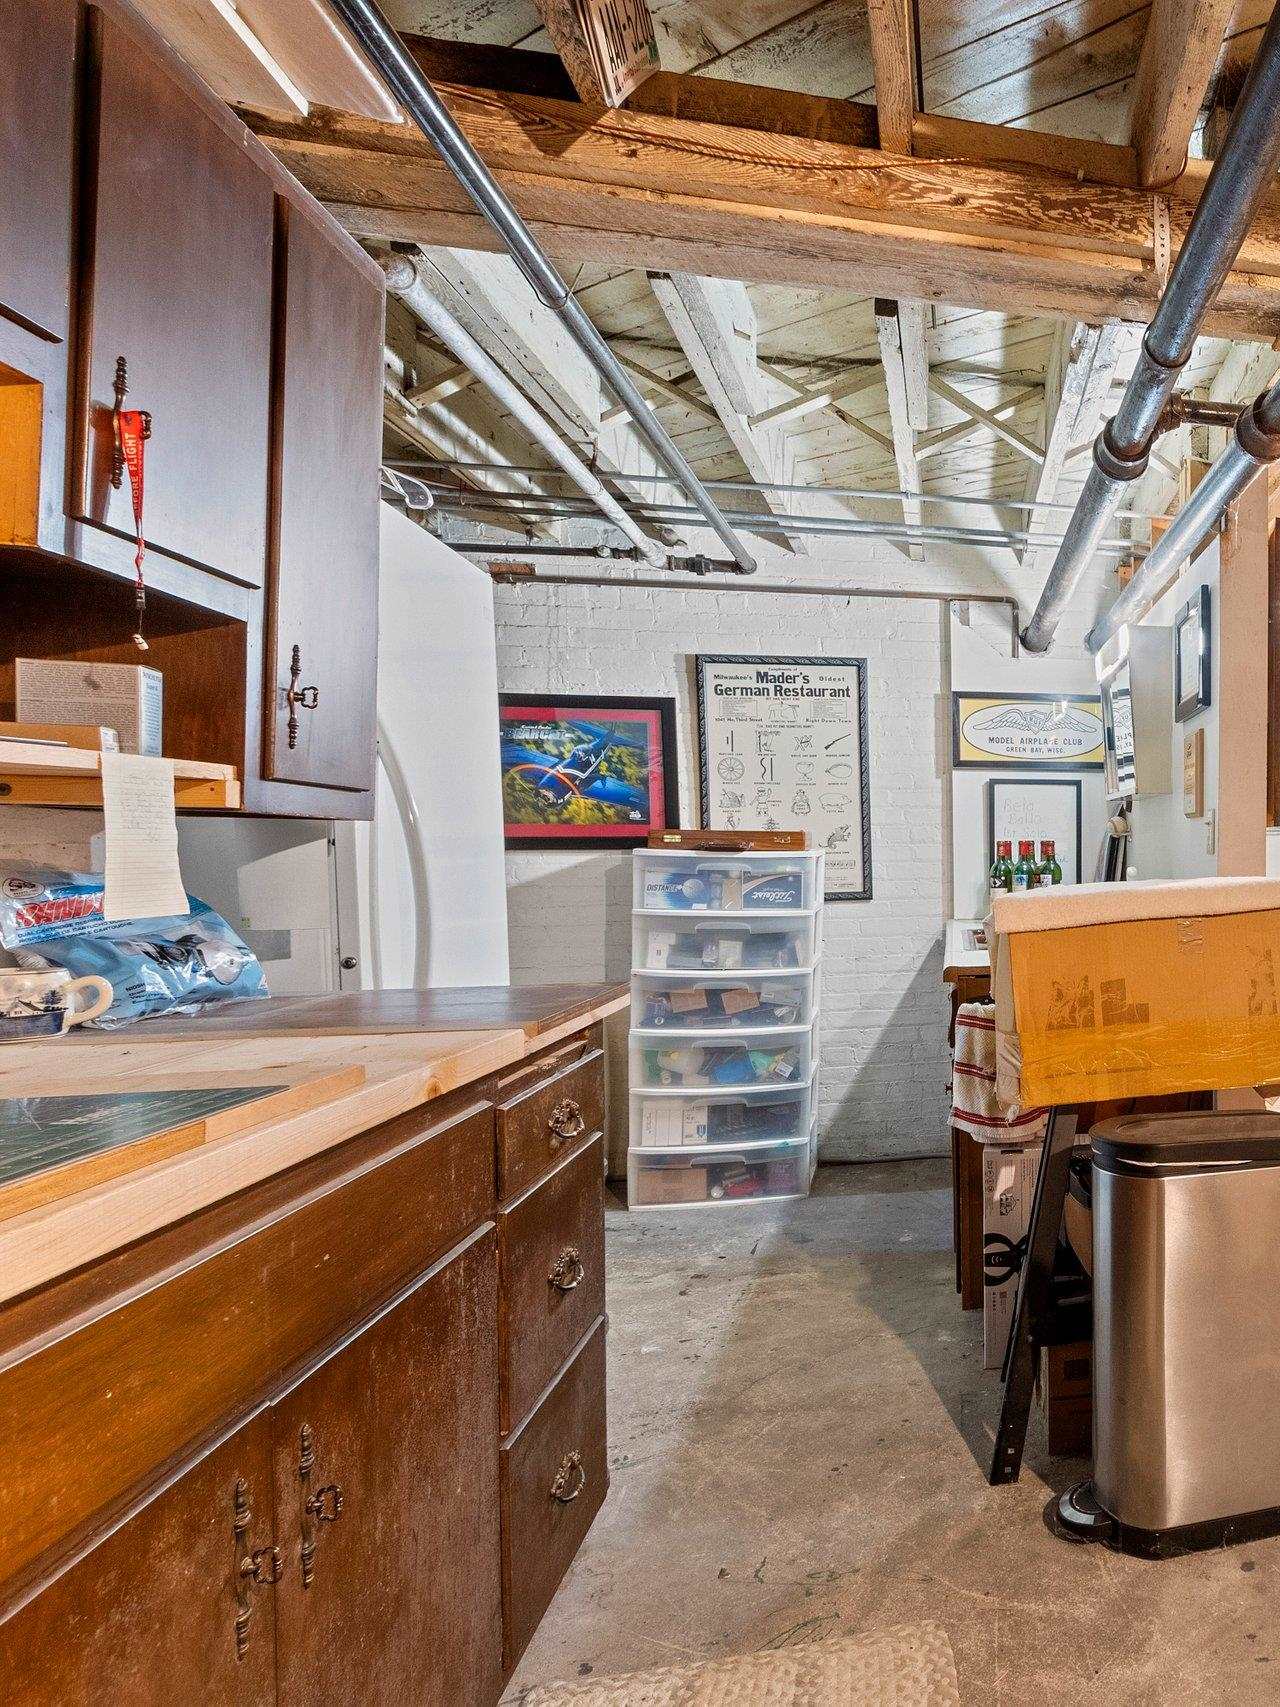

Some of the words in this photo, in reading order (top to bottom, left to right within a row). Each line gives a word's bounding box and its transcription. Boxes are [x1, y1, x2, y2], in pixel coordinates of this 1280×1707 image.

[124, 432, 138, 471] FLIGHT
[756, 671, 810, 684] Mader's
[714, 684, 770, 696] German
[773, 685, 851, 698] Restaurant
[988, 736, 1014, 744] MODEL
[1020, 737, 1059, 745] AIRPLAE
